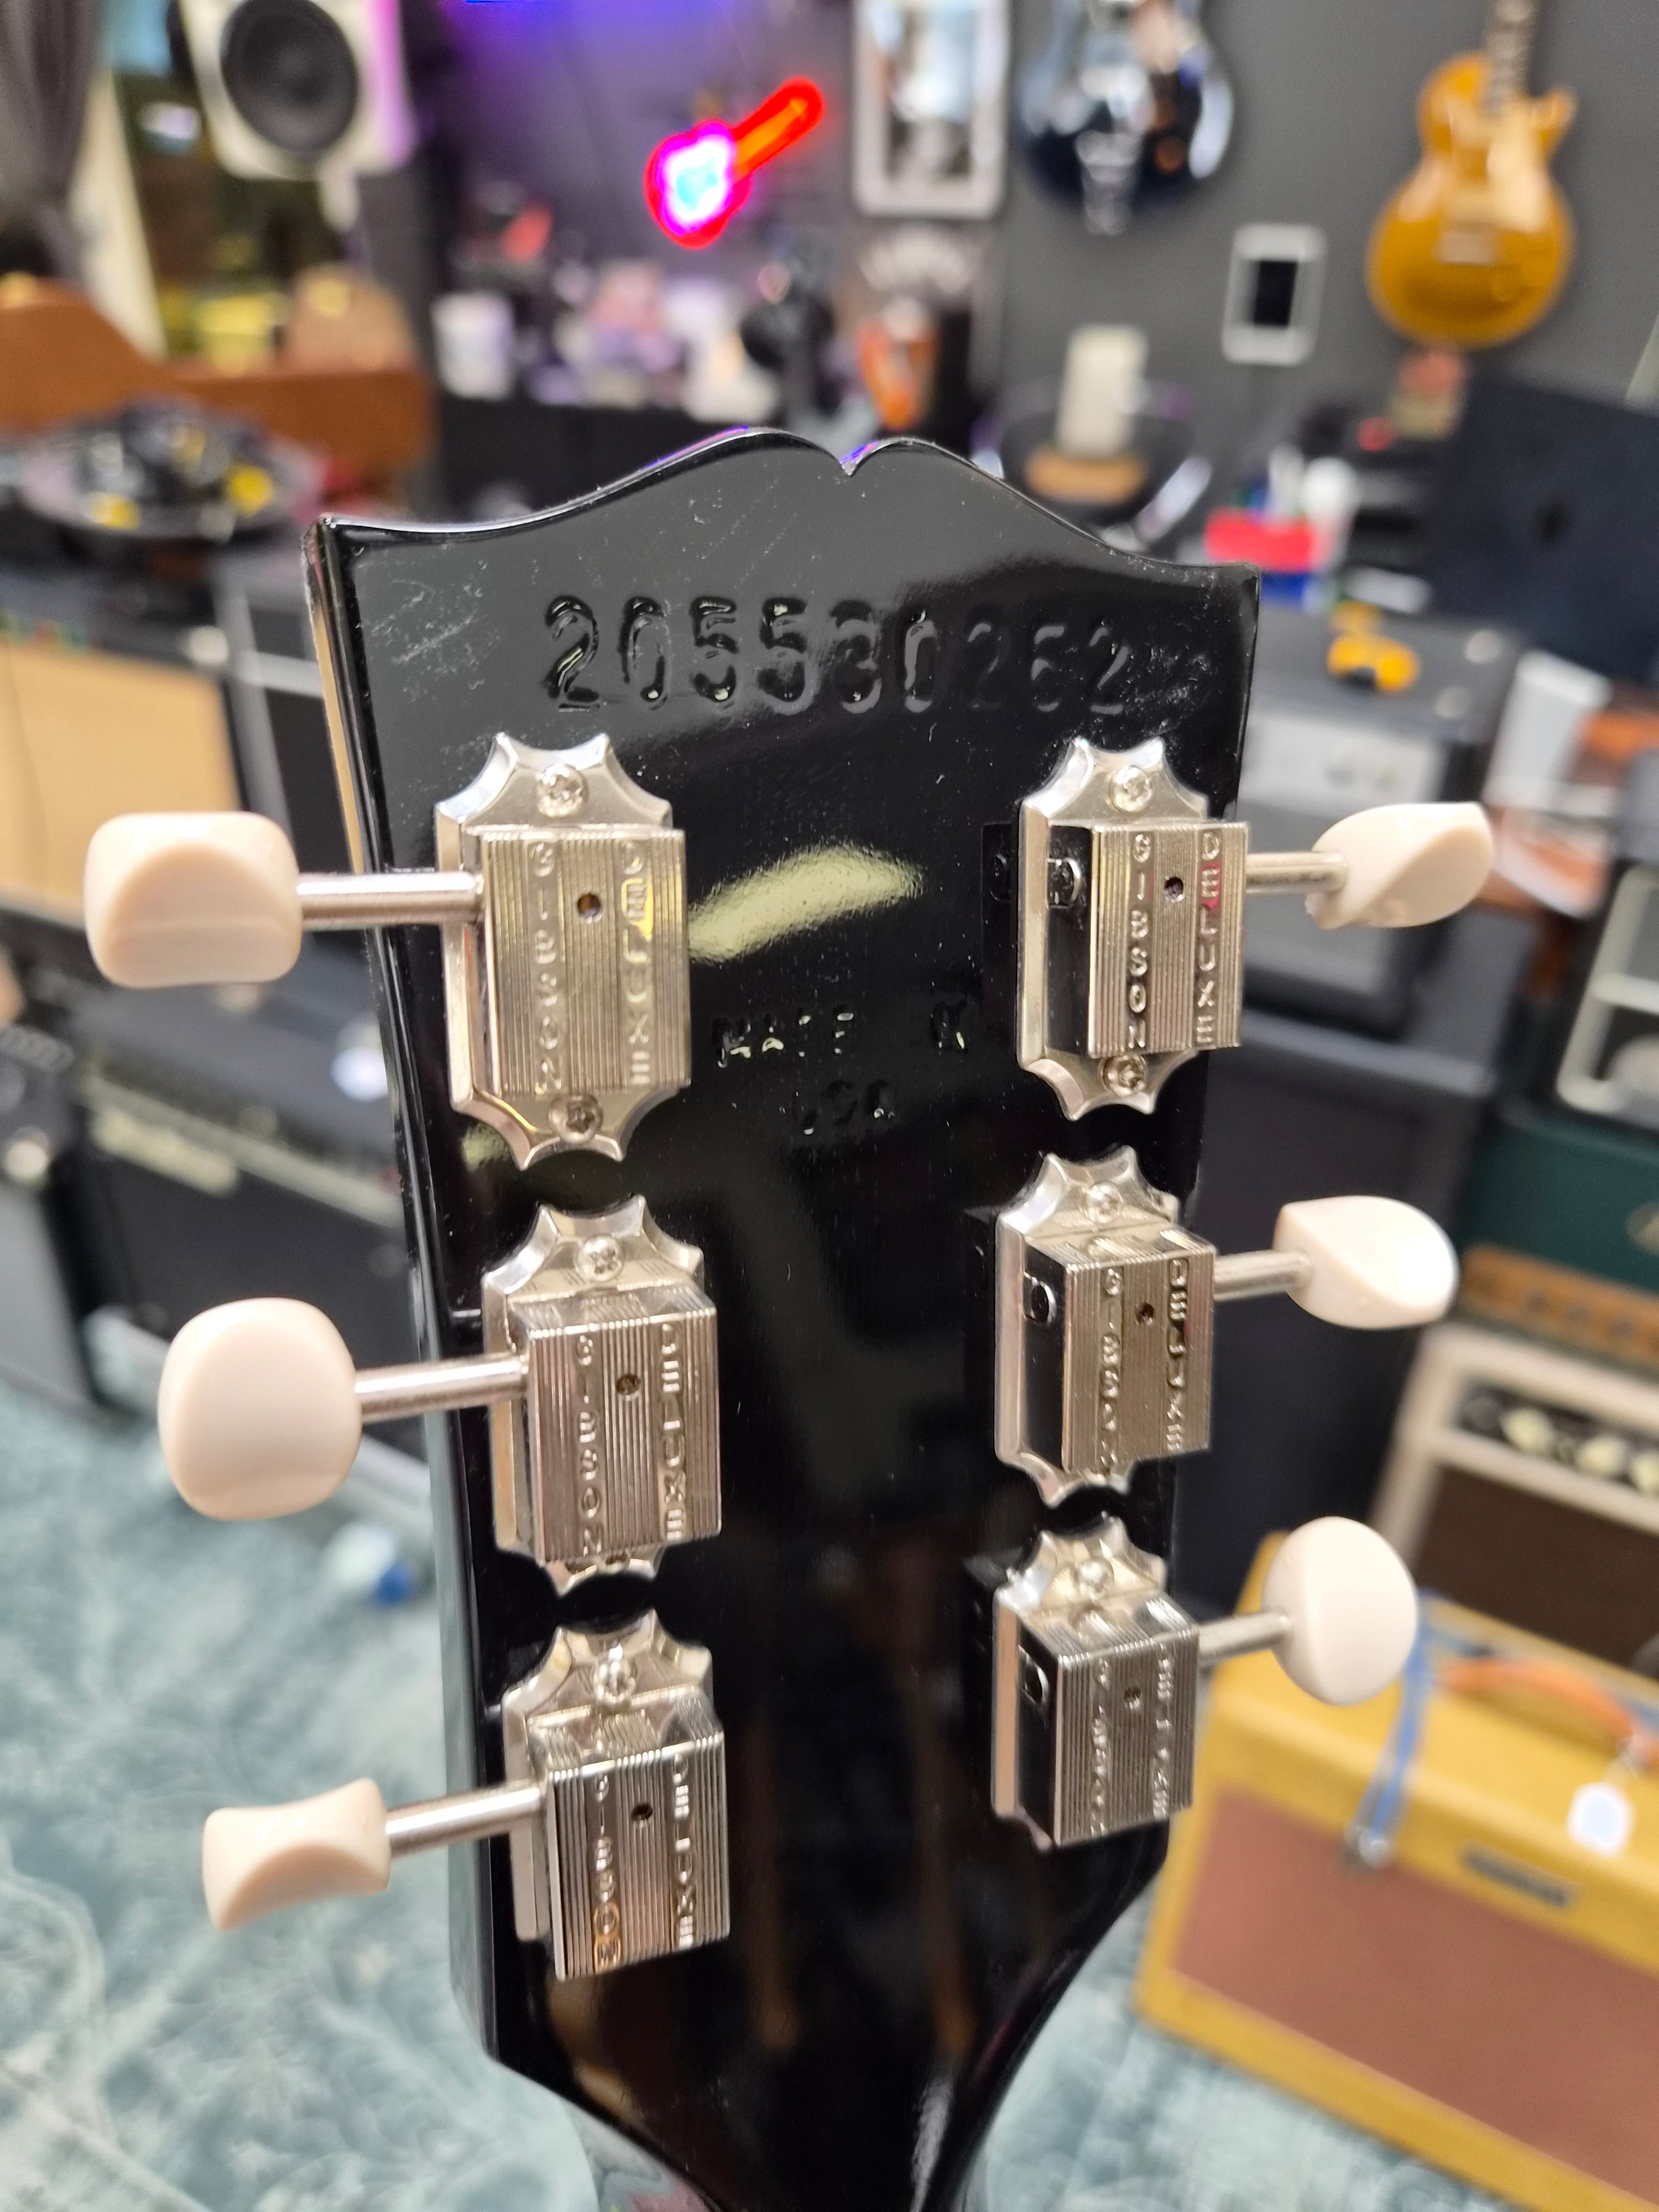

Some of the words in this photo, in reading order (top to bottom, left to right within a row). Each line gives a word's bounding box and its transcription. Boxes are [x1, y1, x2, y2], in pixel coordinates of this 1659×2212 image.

[529, 842, 563, 1095] GIBSON
[620, 839, 653, 1086] DELUXE
[1128, 833, 1151, 1049] GIBSON
[1196, 832, 1220, 1044] DELUXE
[577, 1333, 604, 1557] GIBSON
[661, 1323, 685, 1541] DELUXE
[1100, 1266, 1123, 1467] GIBSON
[1166, 1259, 1189, 1452] DELUXE
